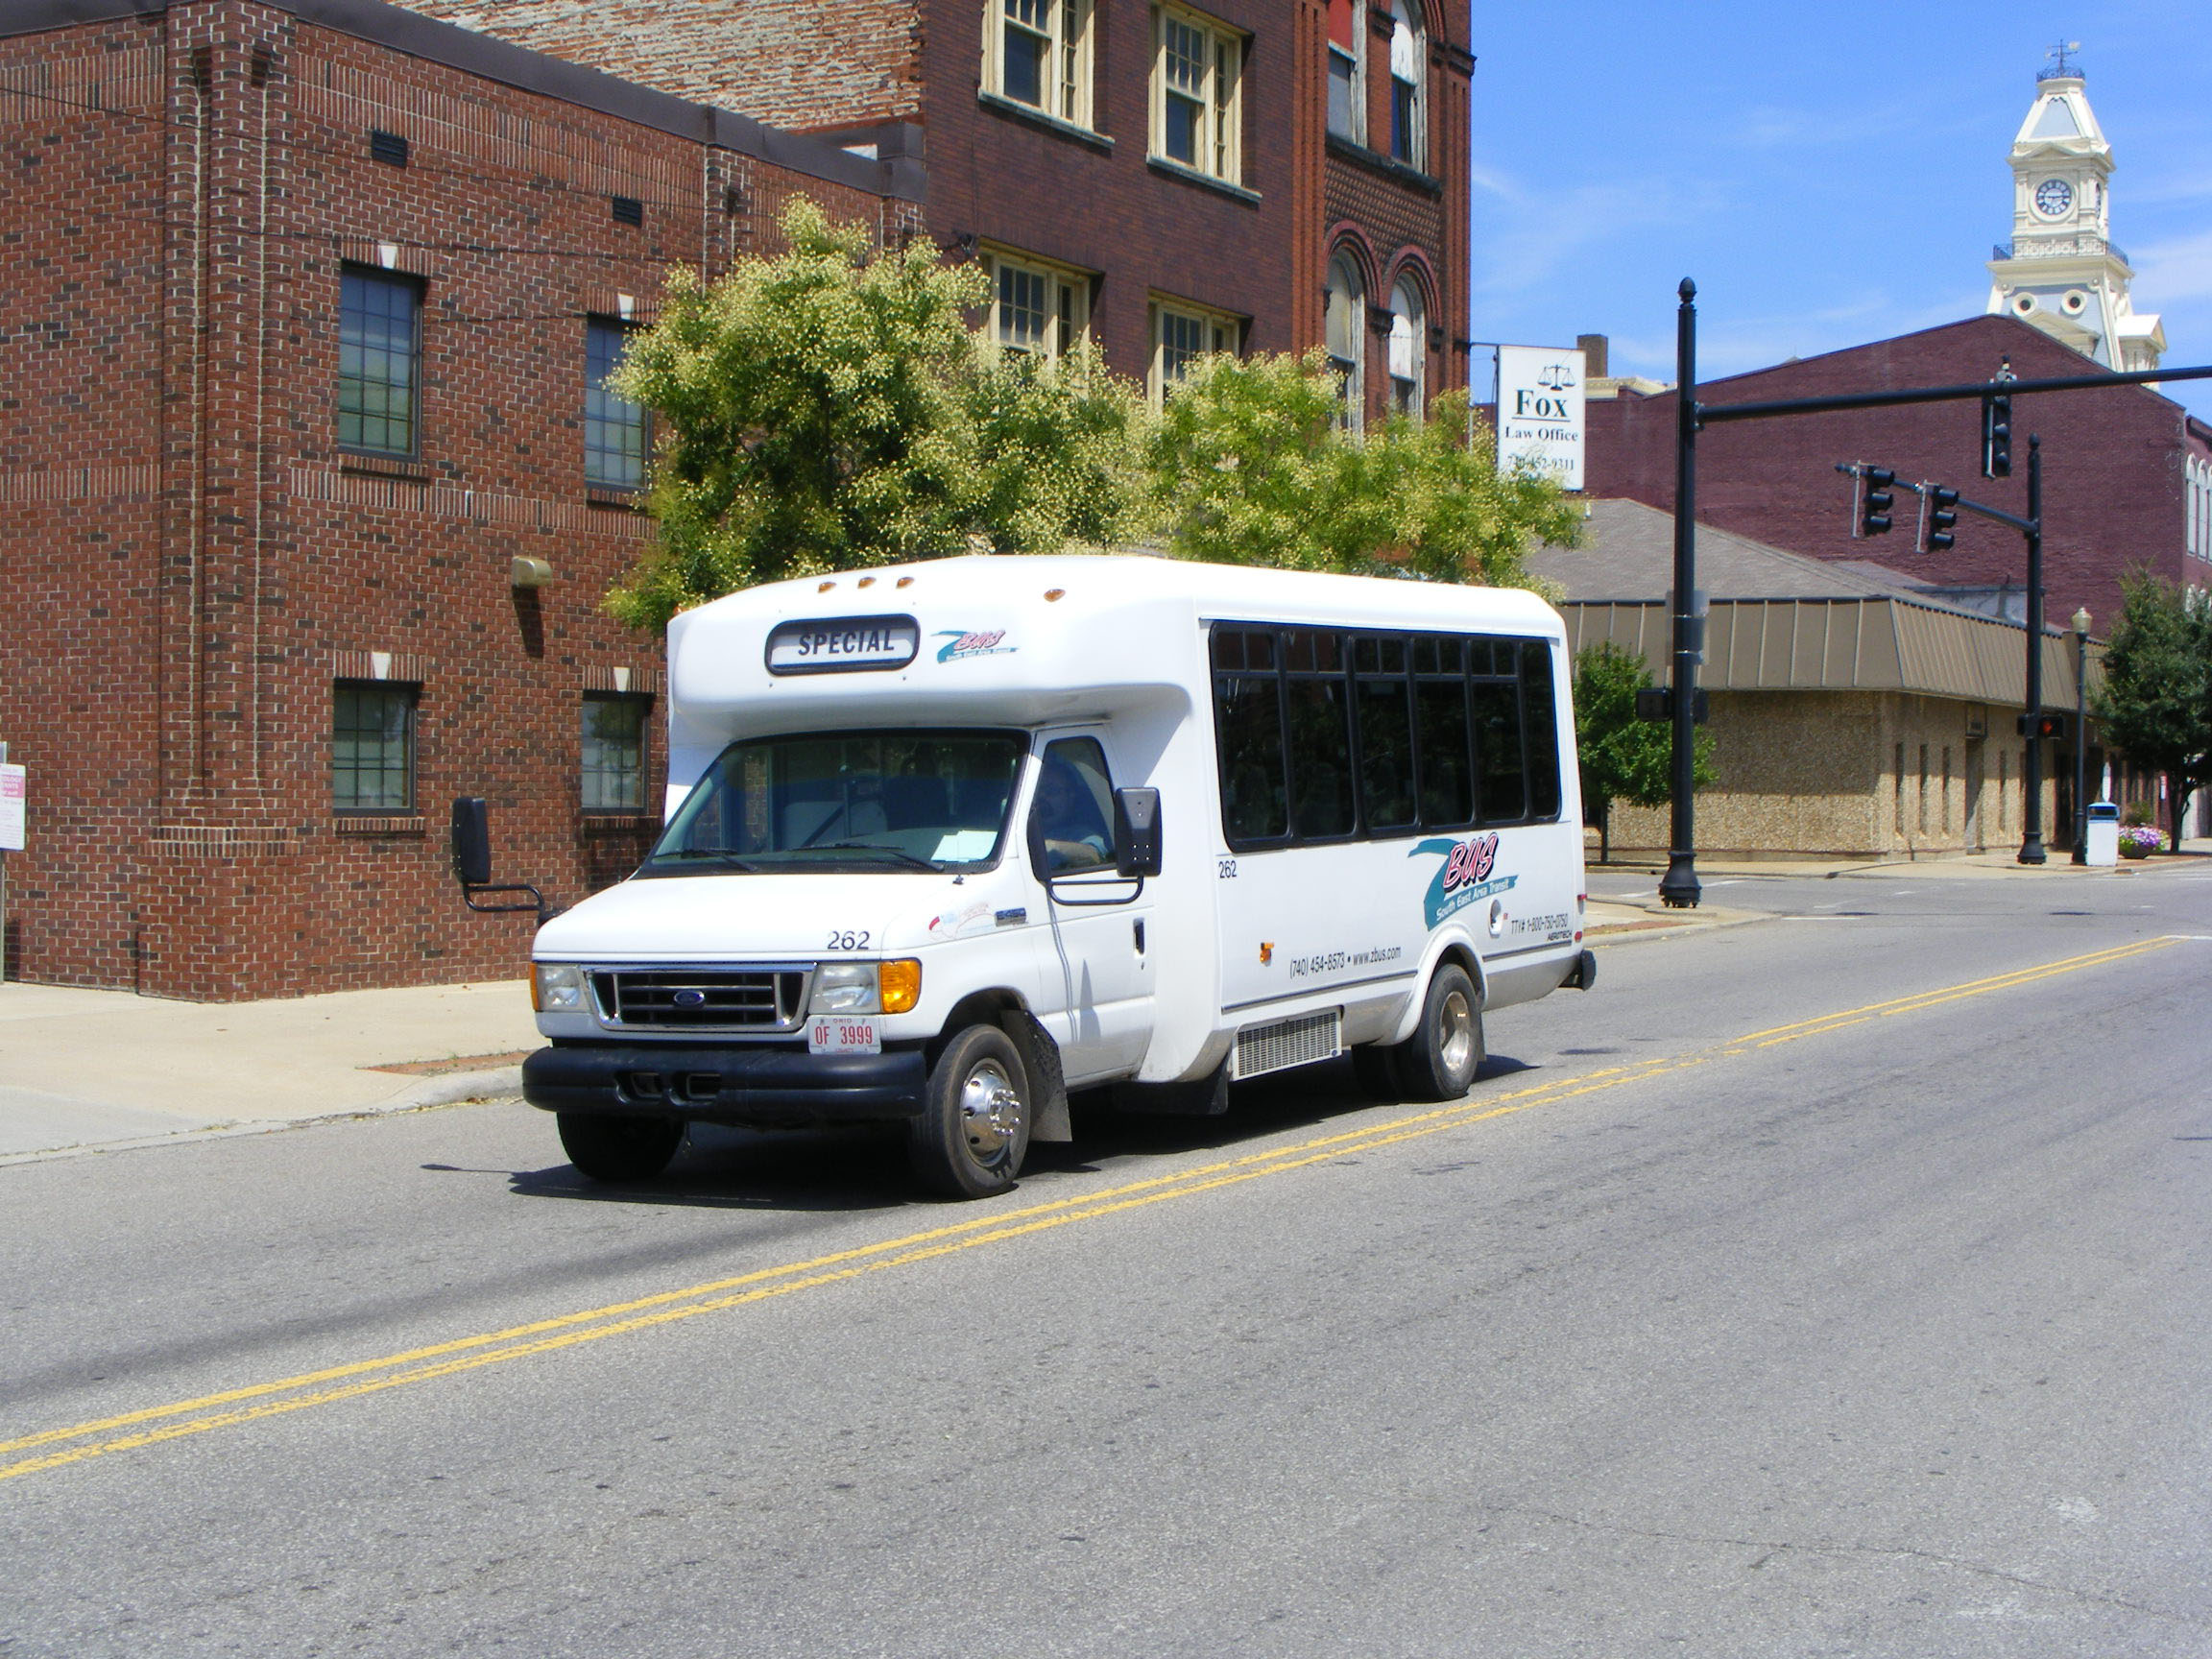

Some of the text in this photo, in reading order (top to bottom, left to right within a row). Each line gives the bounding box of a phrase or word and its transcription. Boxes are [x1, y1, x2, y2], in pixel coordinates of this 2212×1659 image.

[1505, 426, 1578, 442] Law Office
[1507, 455, 1575, 470] 7052-9311
[798, 629, 895, 656] SPECIAL
[1218, 860, 1237, 878] 262
[1443, 831, 1500, 894] BUS
[1435, 878, 1509, 922] South East Area Transit
[828, 930, 870, 950] 262
[1289, 947, 1402, 979] (740) 454-8573 www.zbus.com
[840, 1025, 873, 1045] 3999
